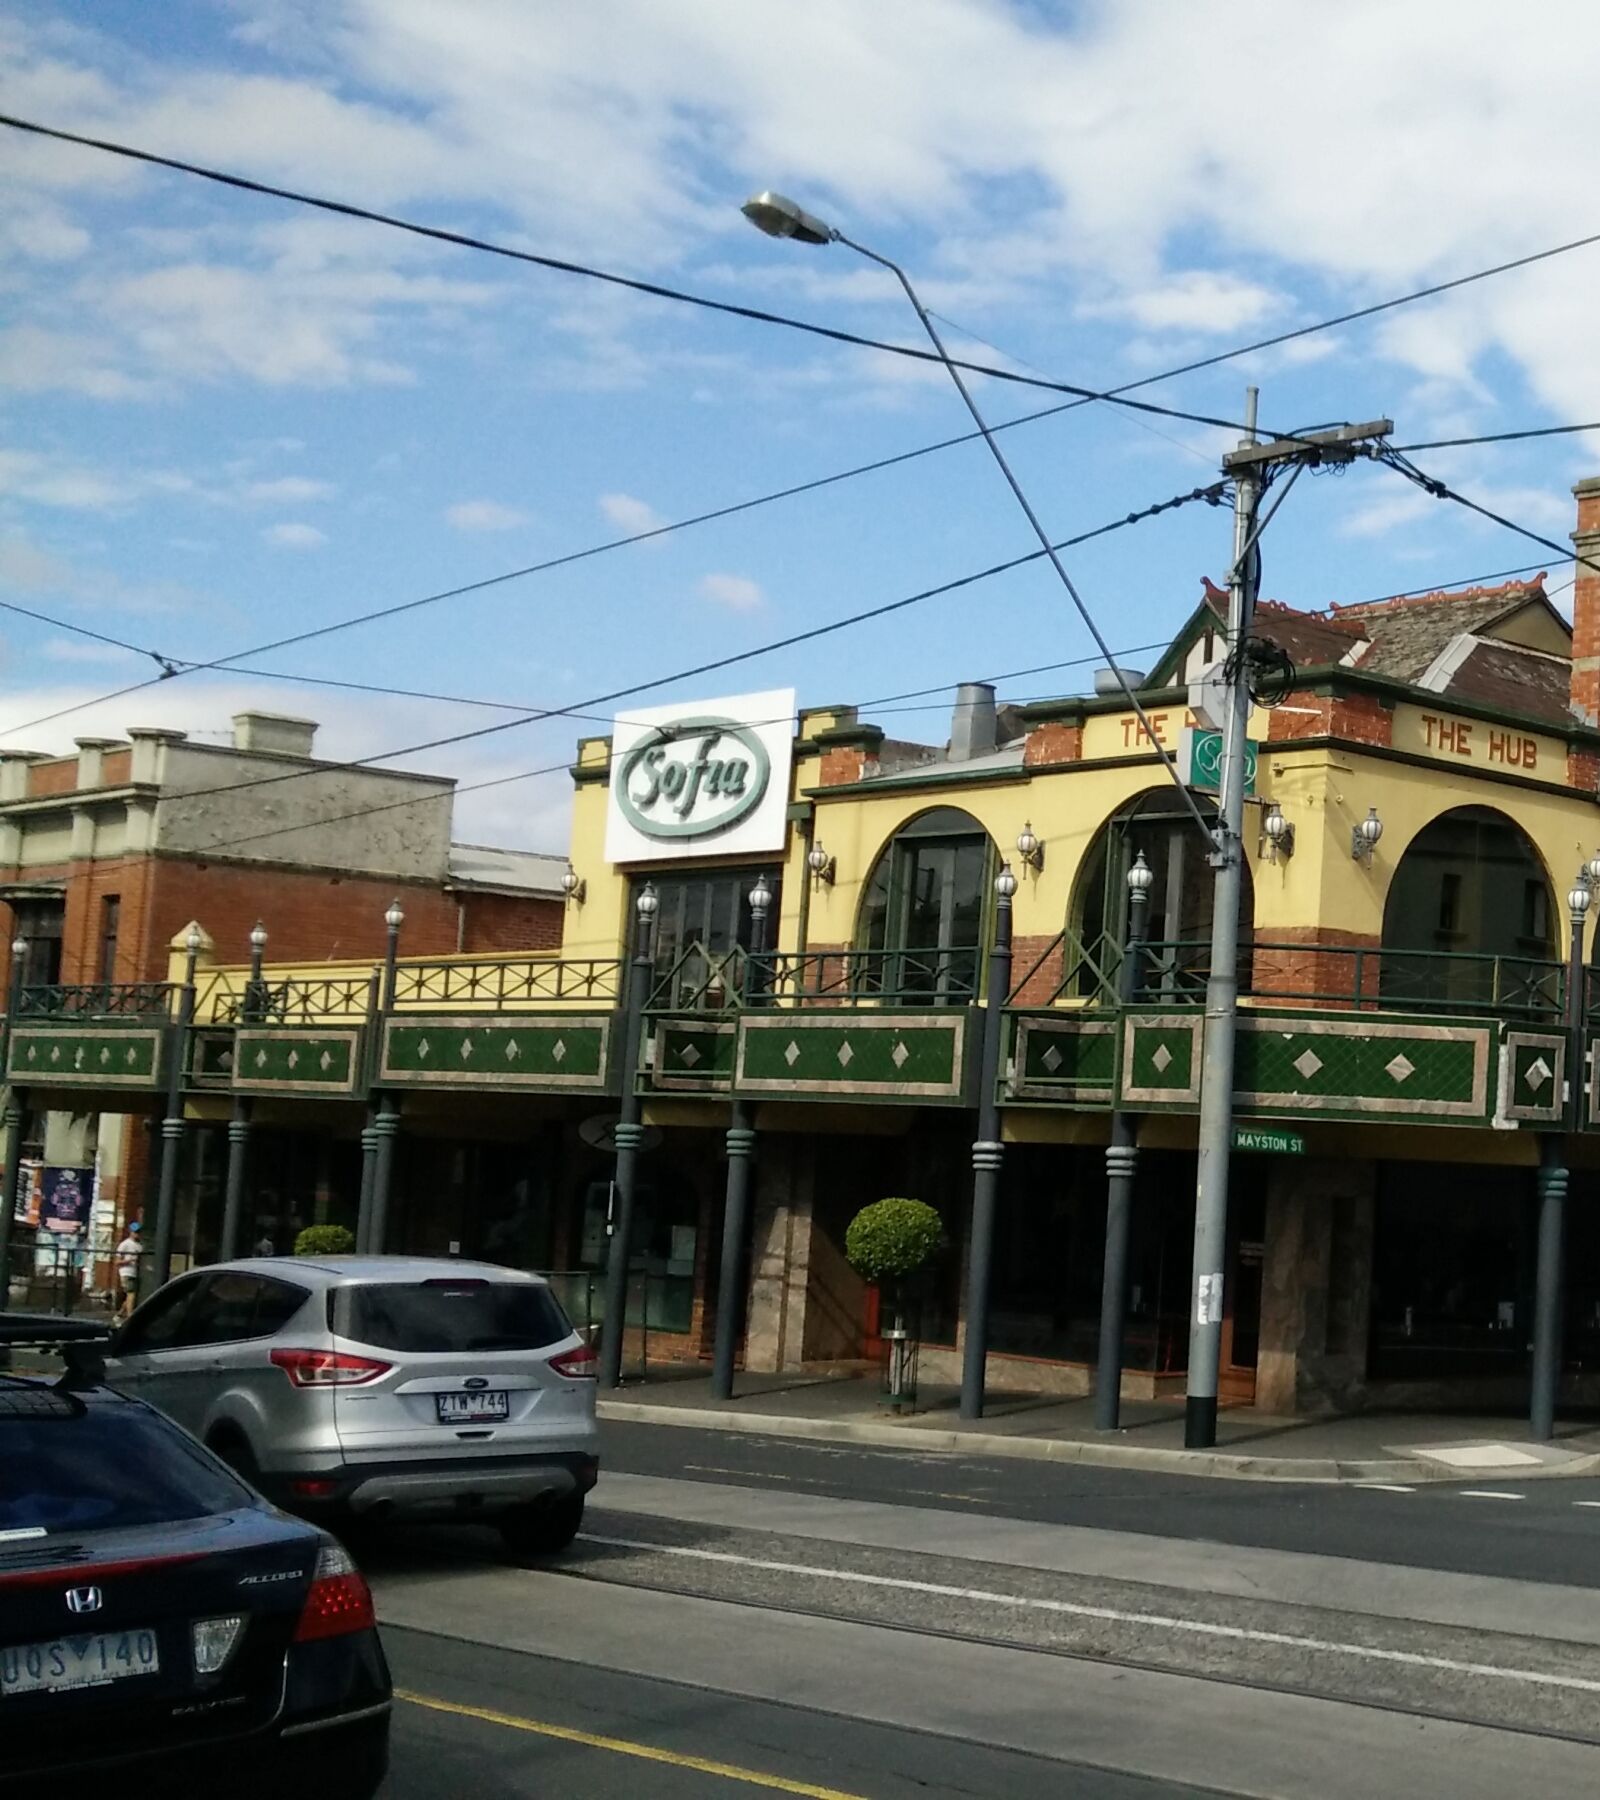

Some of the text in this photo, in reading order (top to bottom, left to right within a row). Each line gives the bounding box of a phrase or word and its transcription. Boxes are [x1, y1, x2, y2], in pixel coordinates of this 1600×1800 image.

[1121, 714, 1168, 747] THE
[1421, 714, 1538, 769] THE HUB
[632, 733, 750, 823] Sofia
[1237, 1133, 1303, 1152] MAYSTON ST
[440, 1393, 505, 1412] ZTW 744
[97, 1632, 154, 1671] 140
